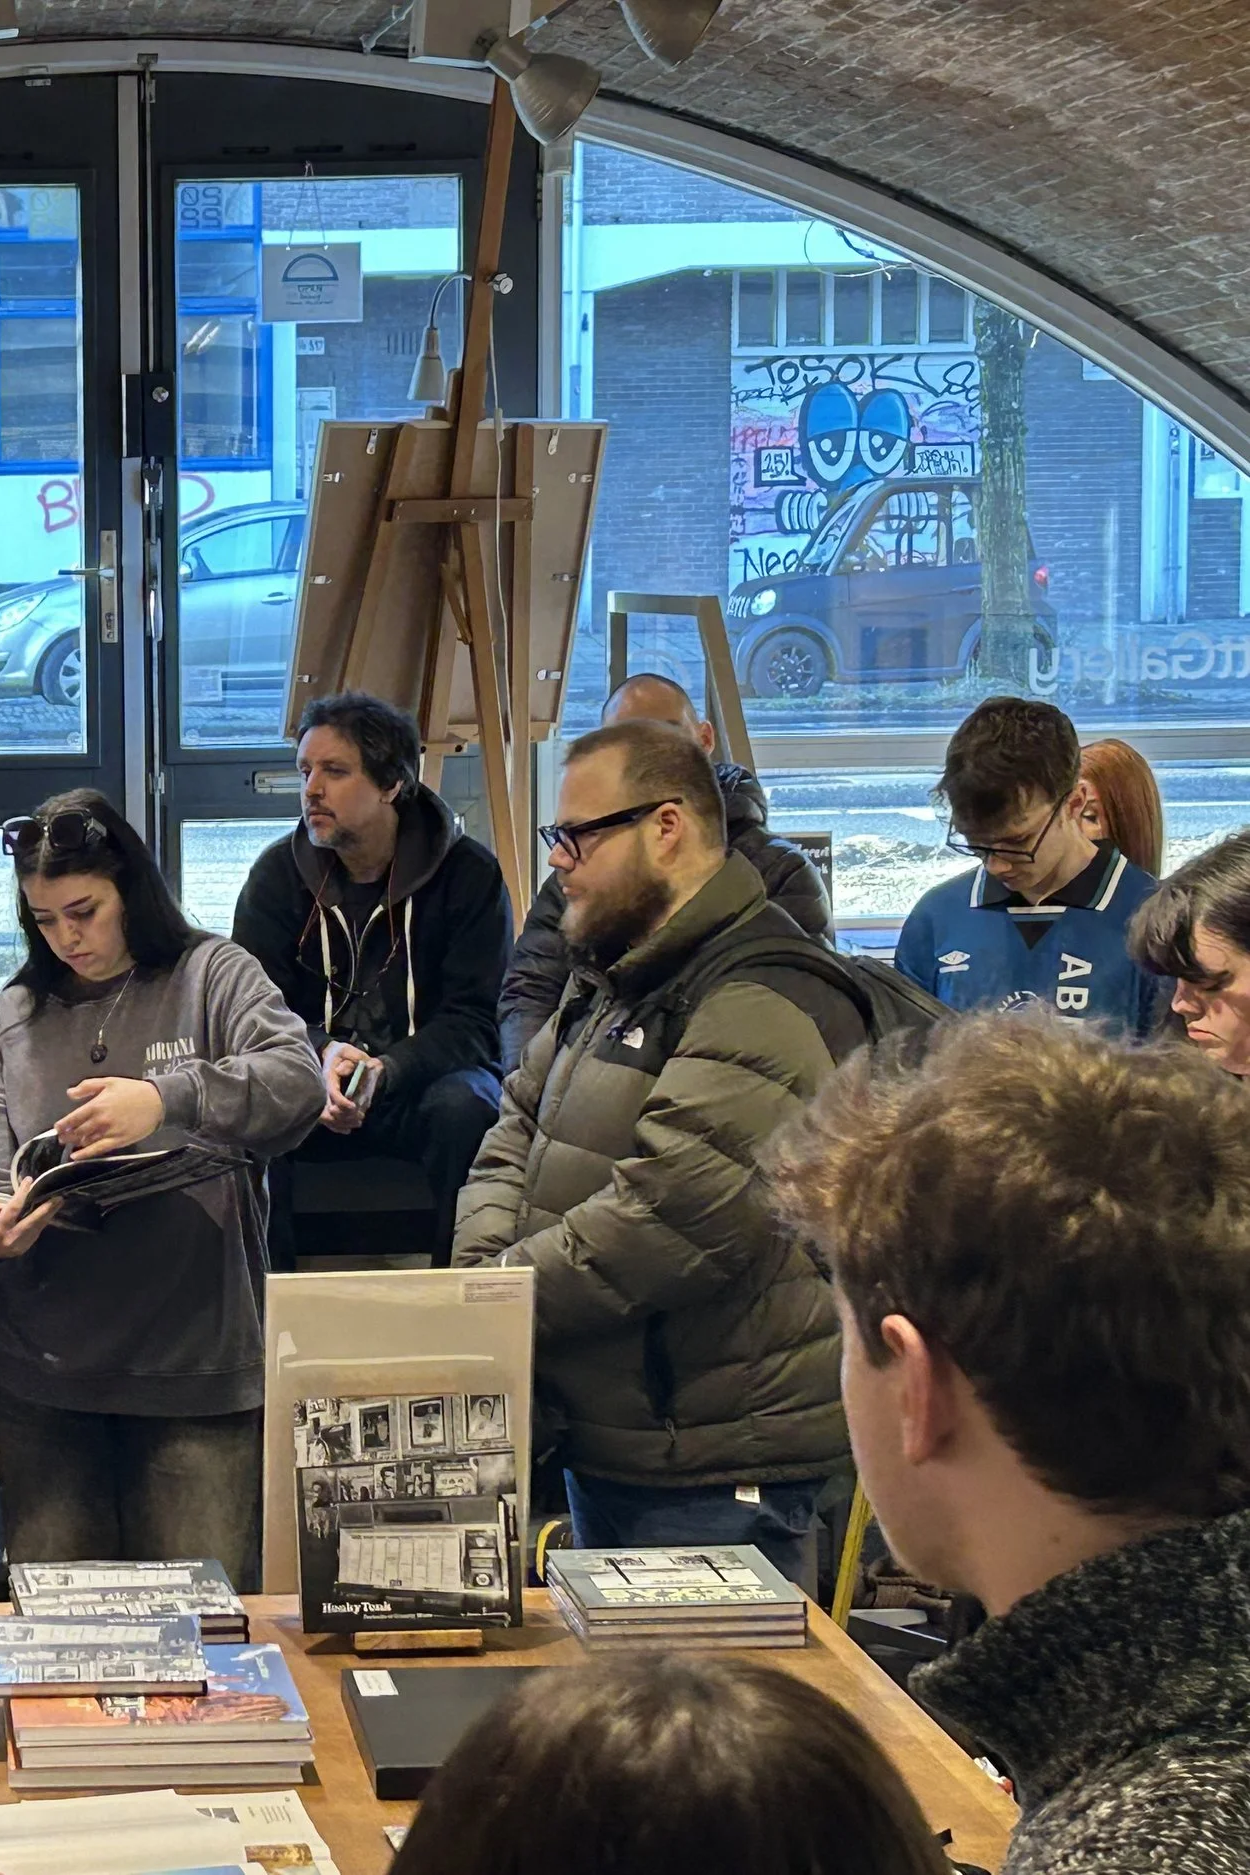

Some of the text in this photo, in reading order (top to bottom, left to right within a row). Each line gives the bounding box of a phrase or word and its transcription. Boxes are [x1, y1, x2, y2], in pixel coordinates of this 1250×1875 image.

[1056, 953, 1093, 1025] AB
[322, 1601, 391, 1614] Honky Tonk
